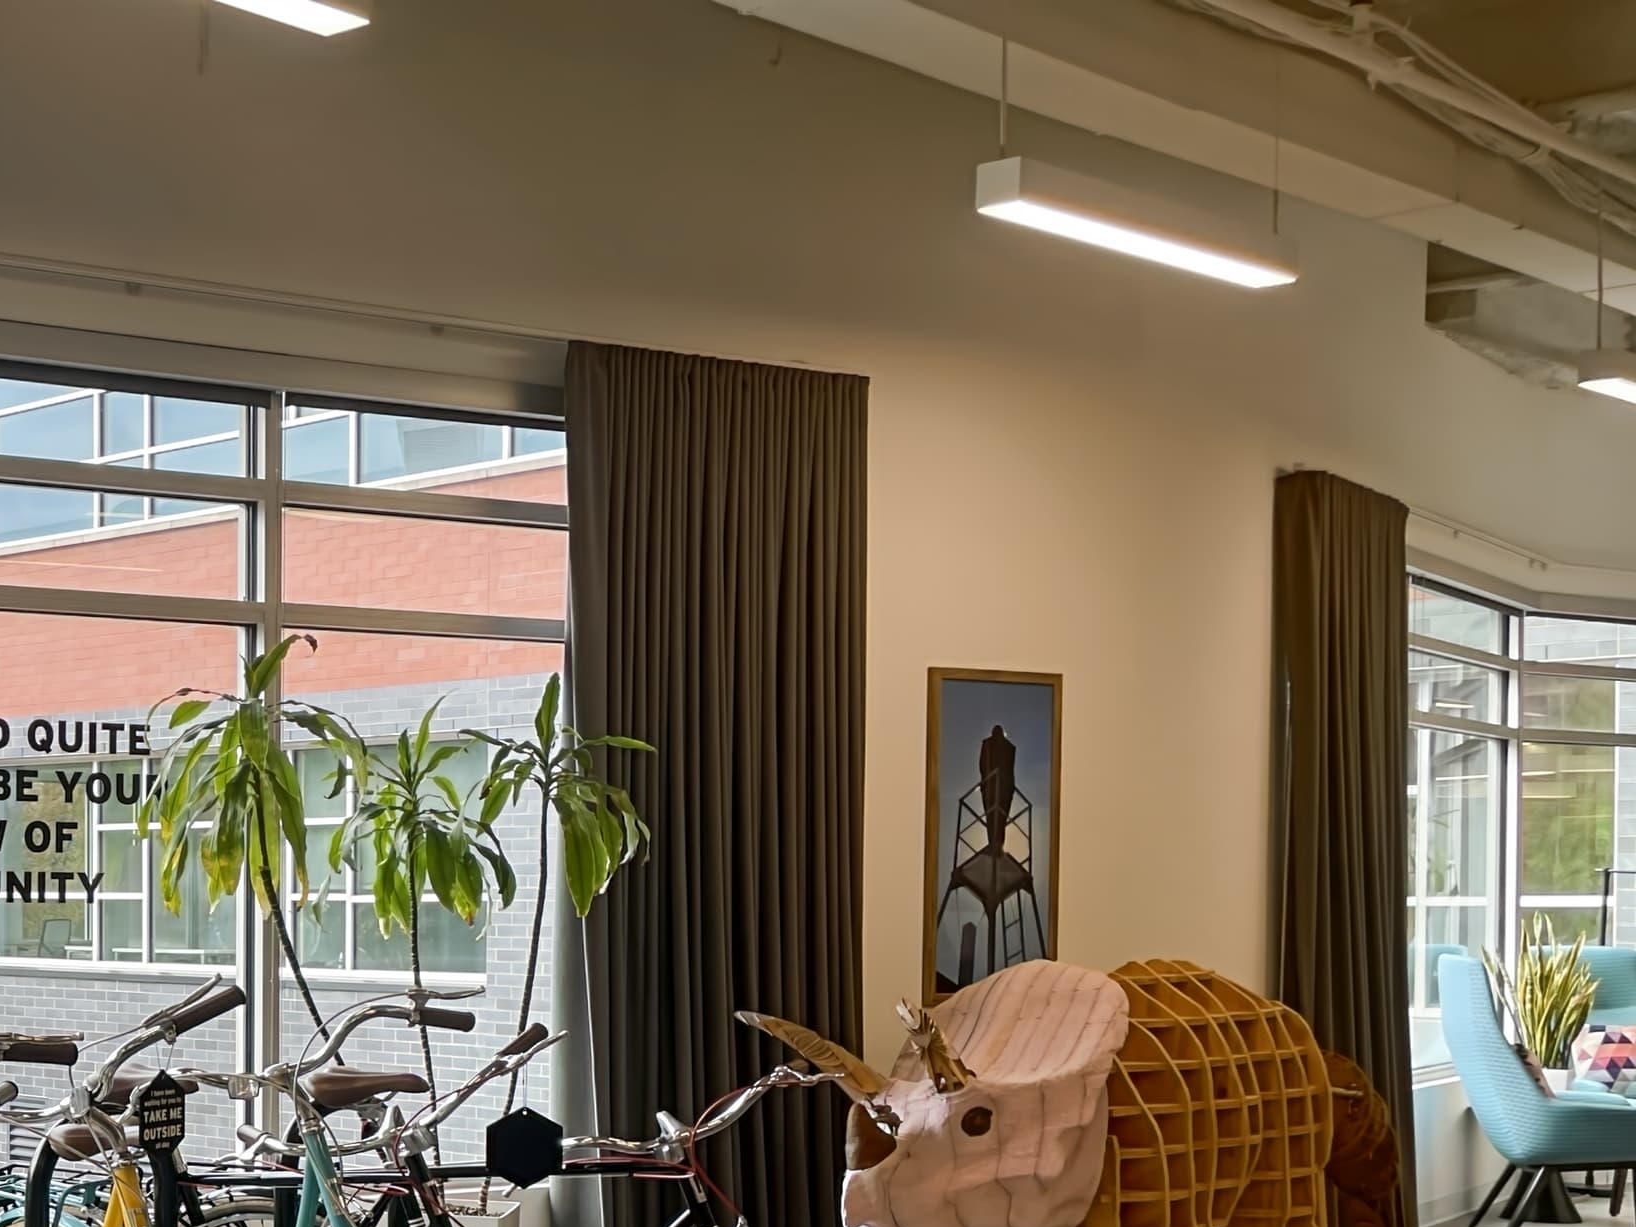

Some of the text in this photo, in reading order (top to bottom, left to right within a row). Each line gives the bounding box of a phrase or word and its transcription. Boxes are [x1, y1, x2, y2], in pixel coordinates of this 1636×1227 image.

[27, 718, 152, 756] QUITE
[24, 821, 78, 853] OF
[144, 1107, 182, 1124] TAKE ME
[144, 1124, 182, 1141] OUTSIDE
